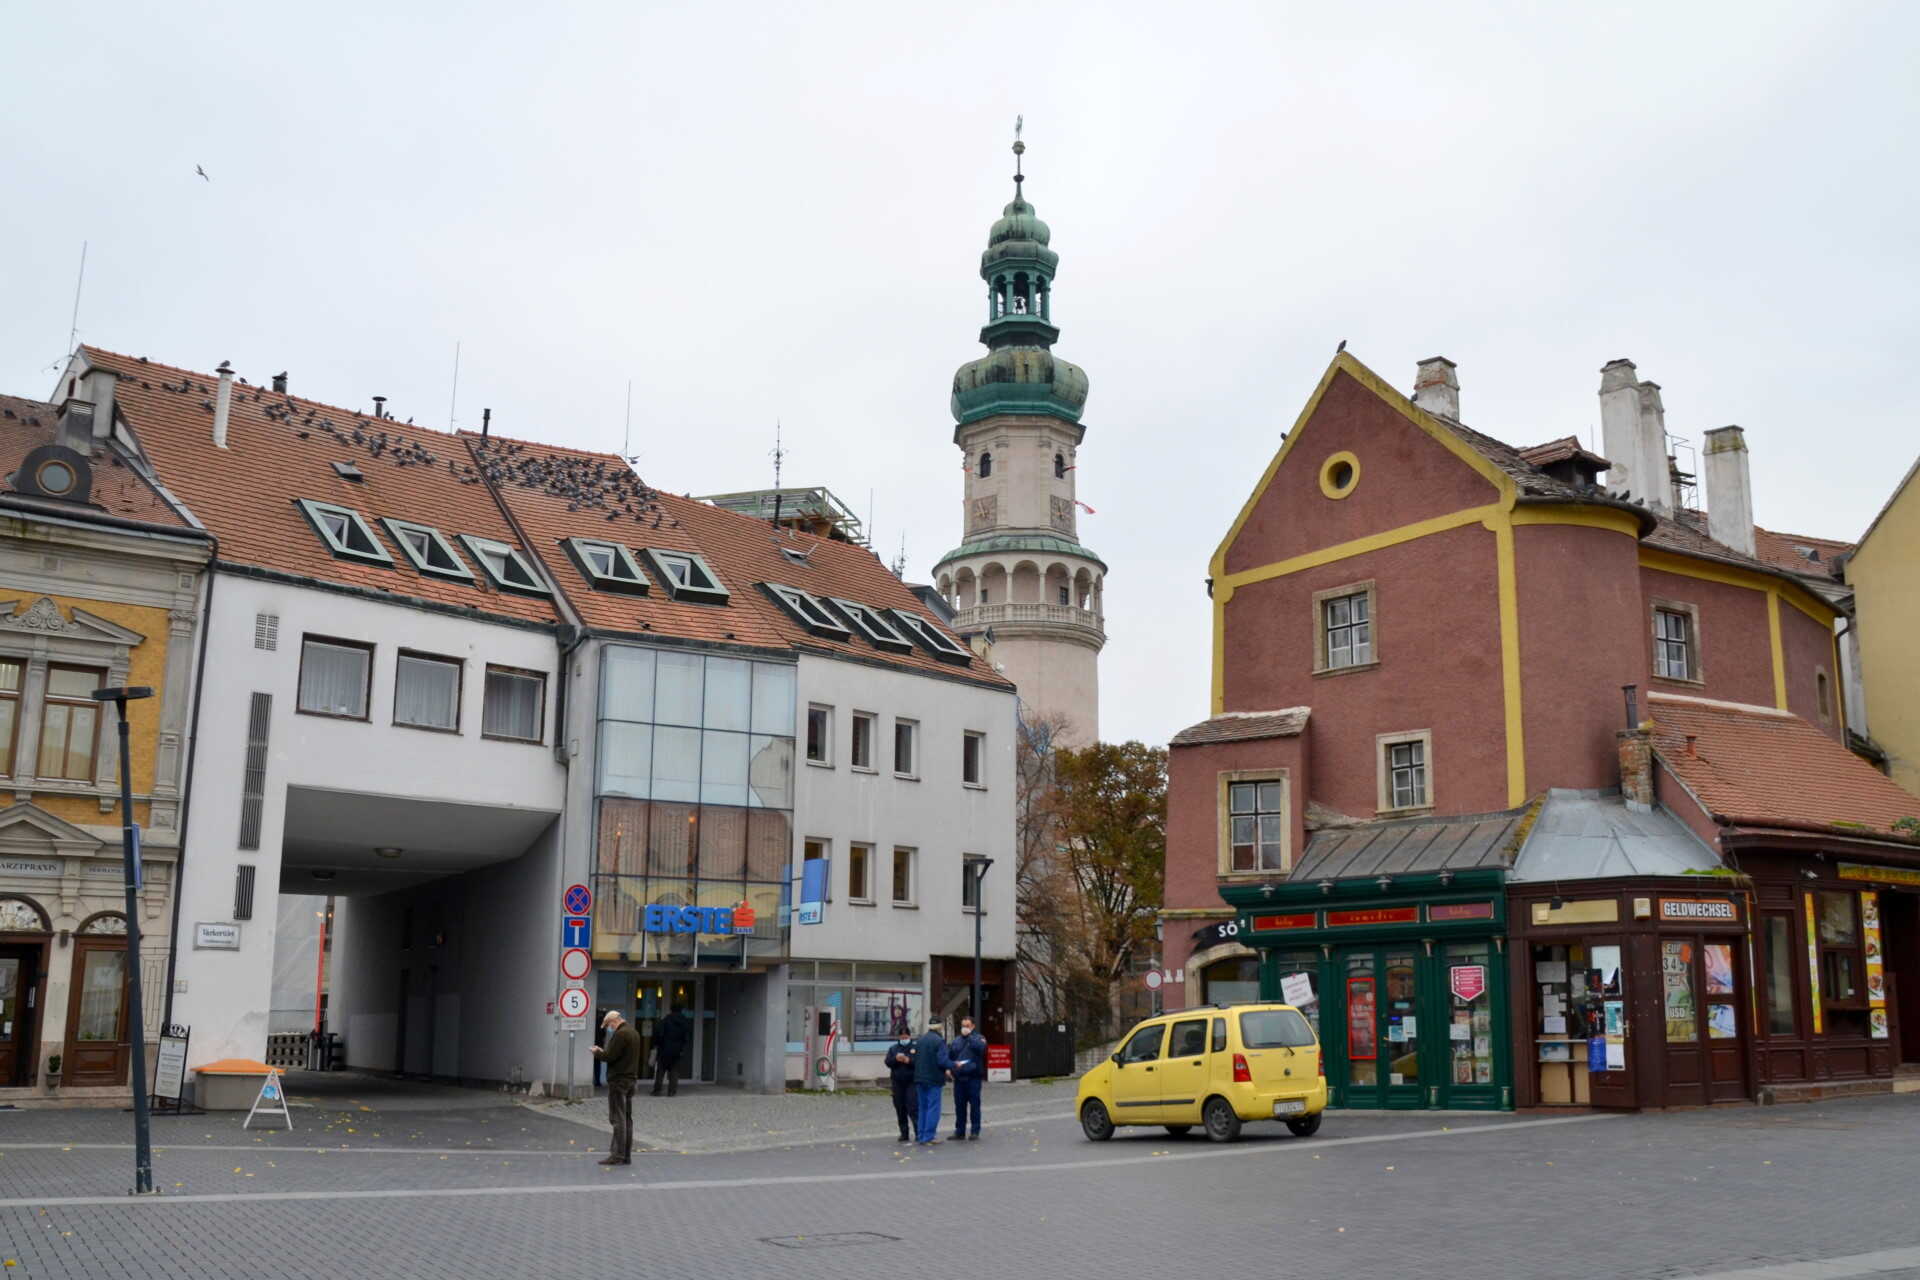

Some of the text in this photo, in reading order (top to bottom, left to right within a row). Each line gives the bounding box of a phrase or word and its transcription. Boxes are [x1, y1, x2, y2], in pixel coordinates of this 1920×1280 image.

[1664, 902, 1732, 917] GELDWECHSEL
[645, 904, 732, 934] ERSTE
[571, 996, 579, 1009] 5
